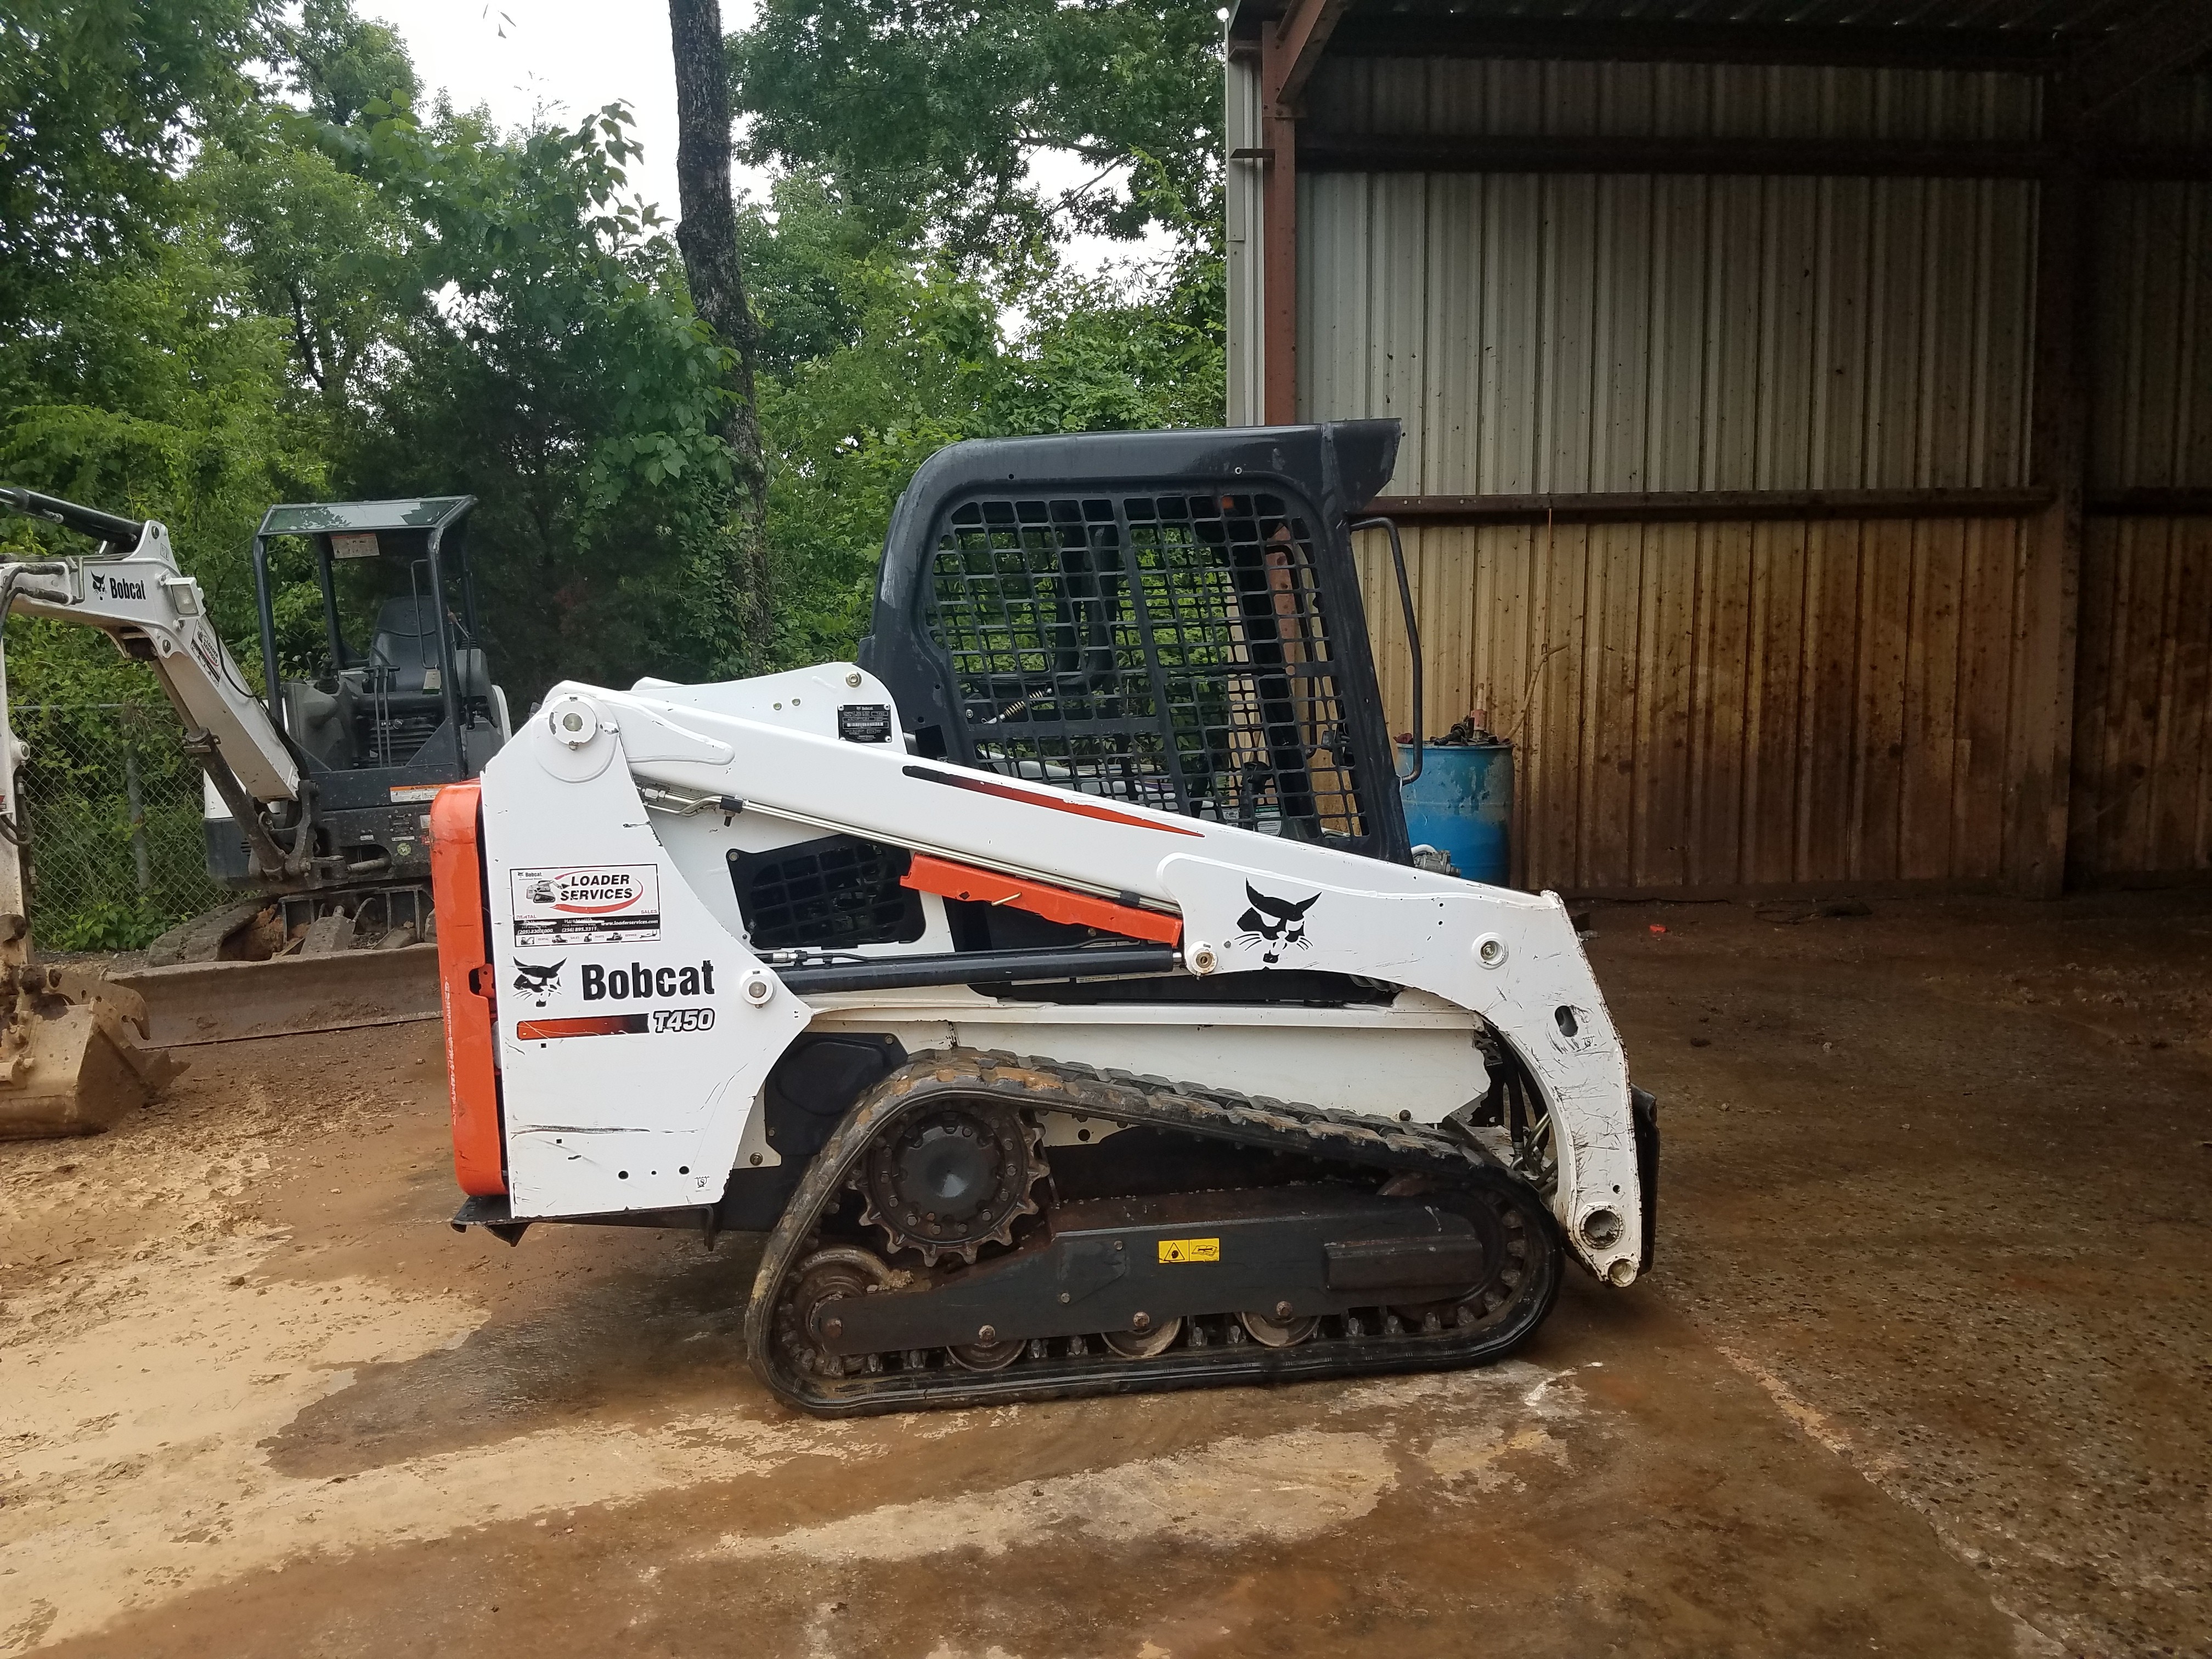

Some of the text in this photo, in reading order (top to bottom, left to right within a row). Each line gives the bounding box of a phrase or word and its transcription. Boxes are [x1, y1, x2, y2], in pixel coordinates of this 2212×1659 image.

[110, 577, 146, 600] Bobcat
[203, 641, 218, 664] SERVICES
[206, 639, 218, 659] LOADER
[571, 874, 630, 887] LOADER
[560, 888, 633, 901] SERVICES
[582, 960, 715, 1001] Bobcat
[653, 1008, 715, 1034] T450
